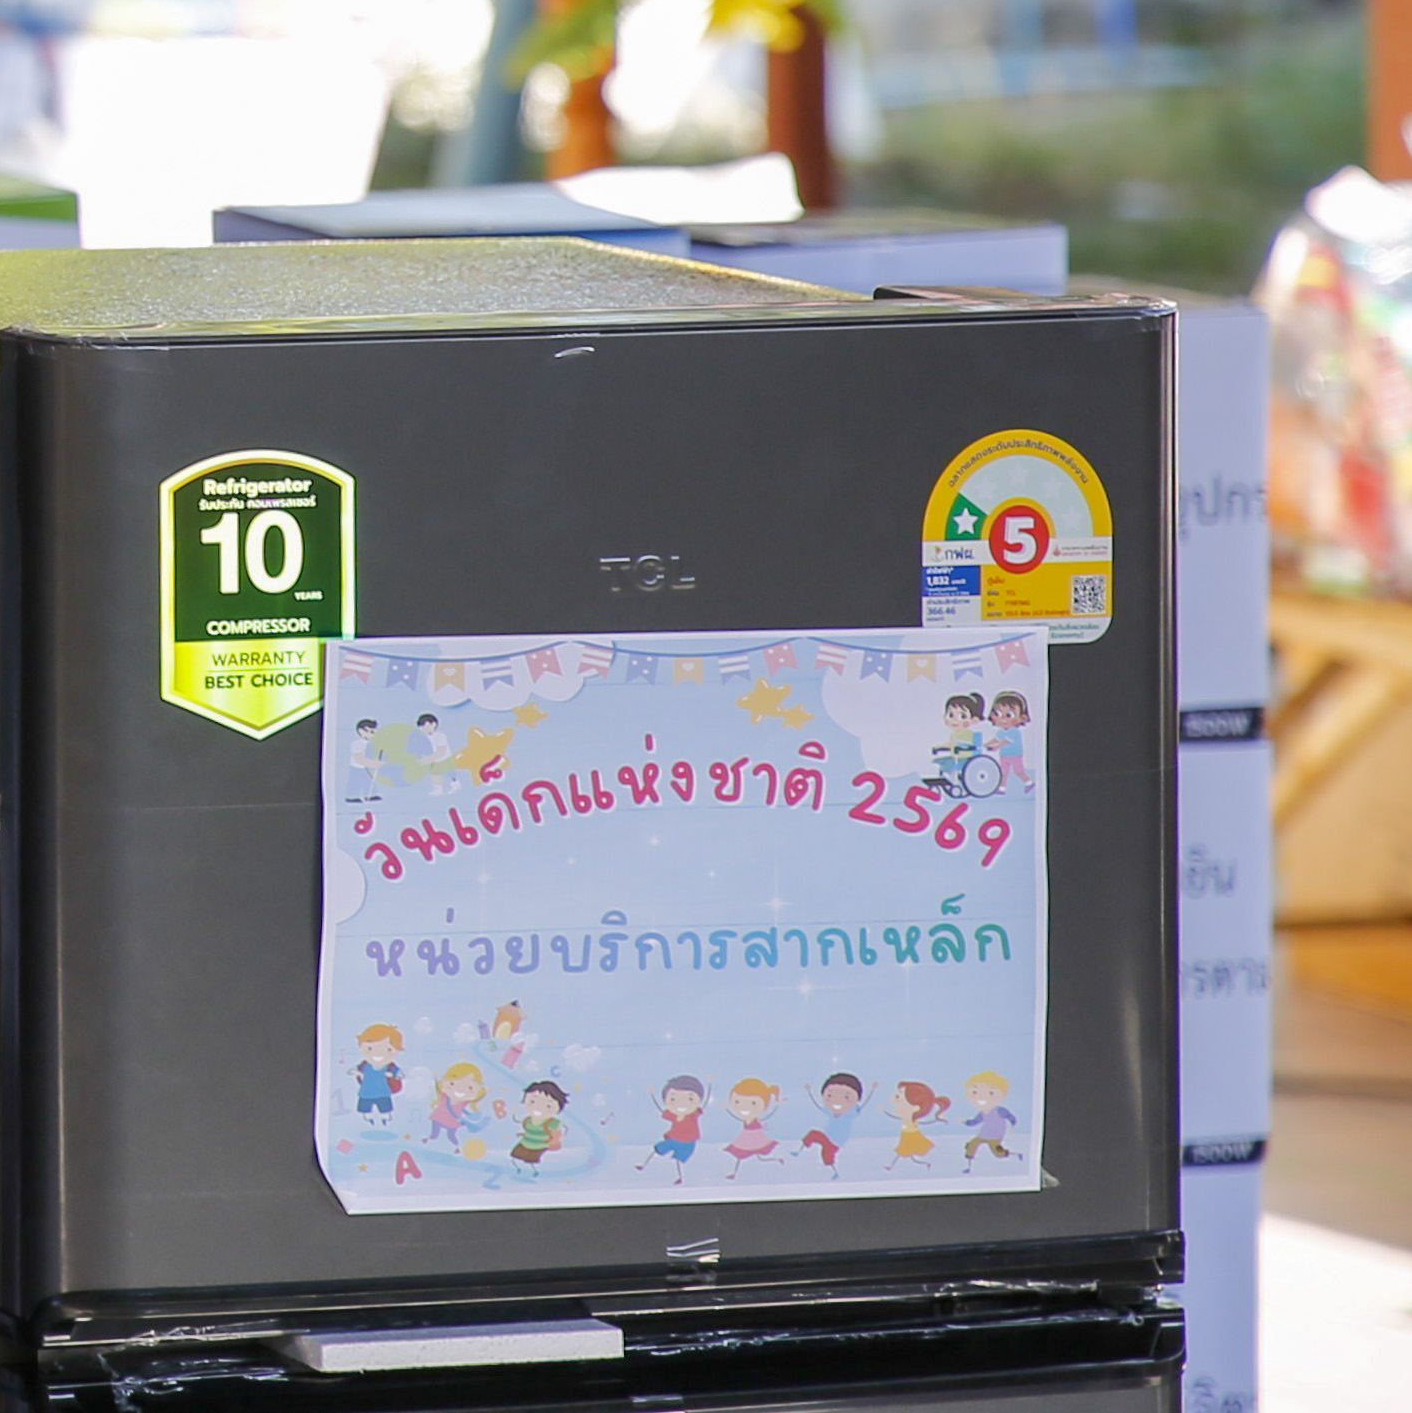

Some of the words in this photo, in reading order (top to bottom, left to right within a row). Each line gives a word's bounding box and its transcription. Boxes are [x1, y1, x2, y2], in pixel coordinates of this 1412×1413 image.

[202, 477, 313, 498] Refrigerator
[200, 509, 304, 594] 10
[1003, 515, 1038, 565] 5
[599, 554, 696, 592] TCL
[293, 590, 323, 601] YEARS
[205, 617, 311, 636] COMPRESSOR
[211, 650, 306, 666] WARRANTY
[204, 674, 245, 689] BEST
[251, 672, 314, 688] CHOICE
[847, 771, 1012, 868] 2569
[364, 892, 1012, 978] หน่วยบริการสากเหล็ก
[394, 1150, 423, 1185] A
